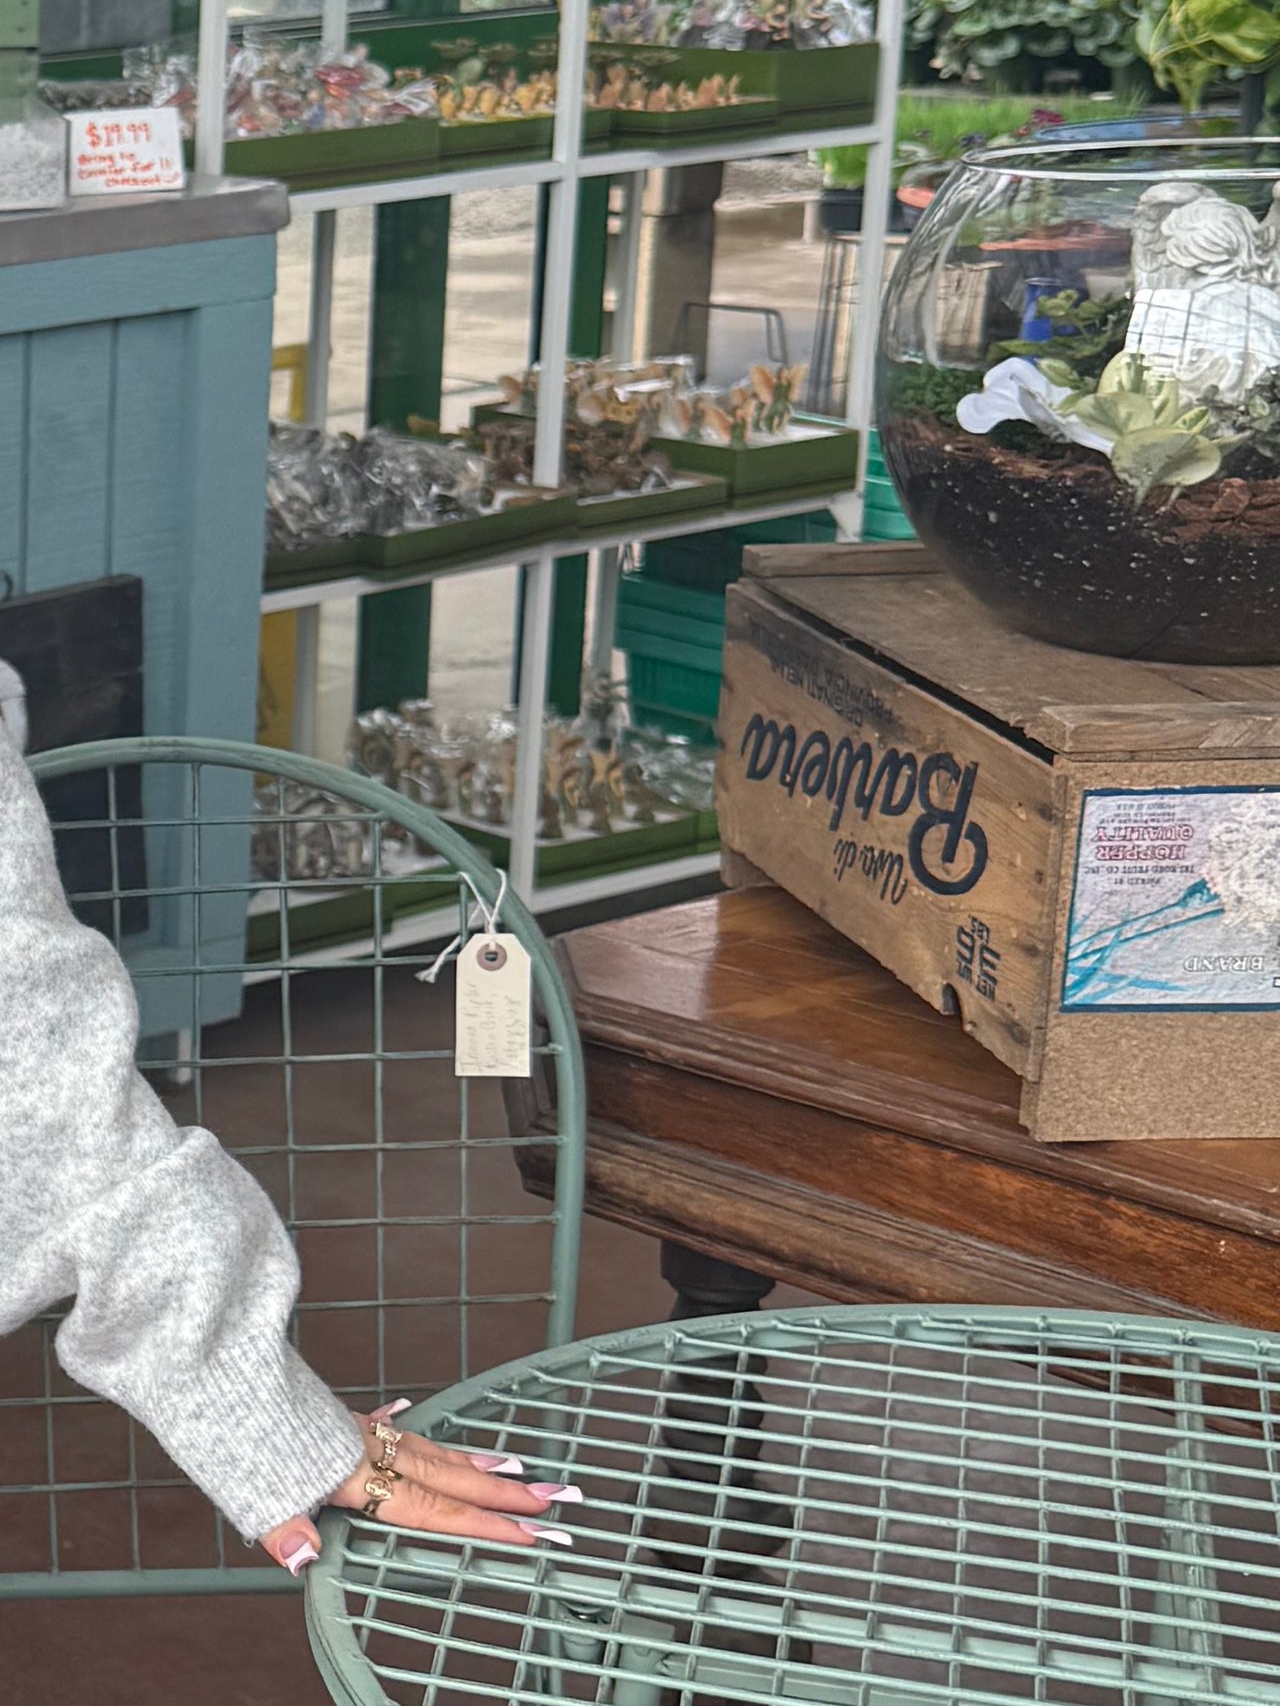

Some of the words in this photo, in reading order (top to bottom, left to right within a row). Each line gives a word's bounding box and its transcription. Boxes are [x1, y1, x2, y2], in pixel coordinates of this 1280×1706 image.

[739, 713, 988, 896] Barbera
[1089, 824, 1194, 842] QUALITY
[1095, 844, 1188, 861] HOPPER
[1183, 955, 1265, 972] BRAND
